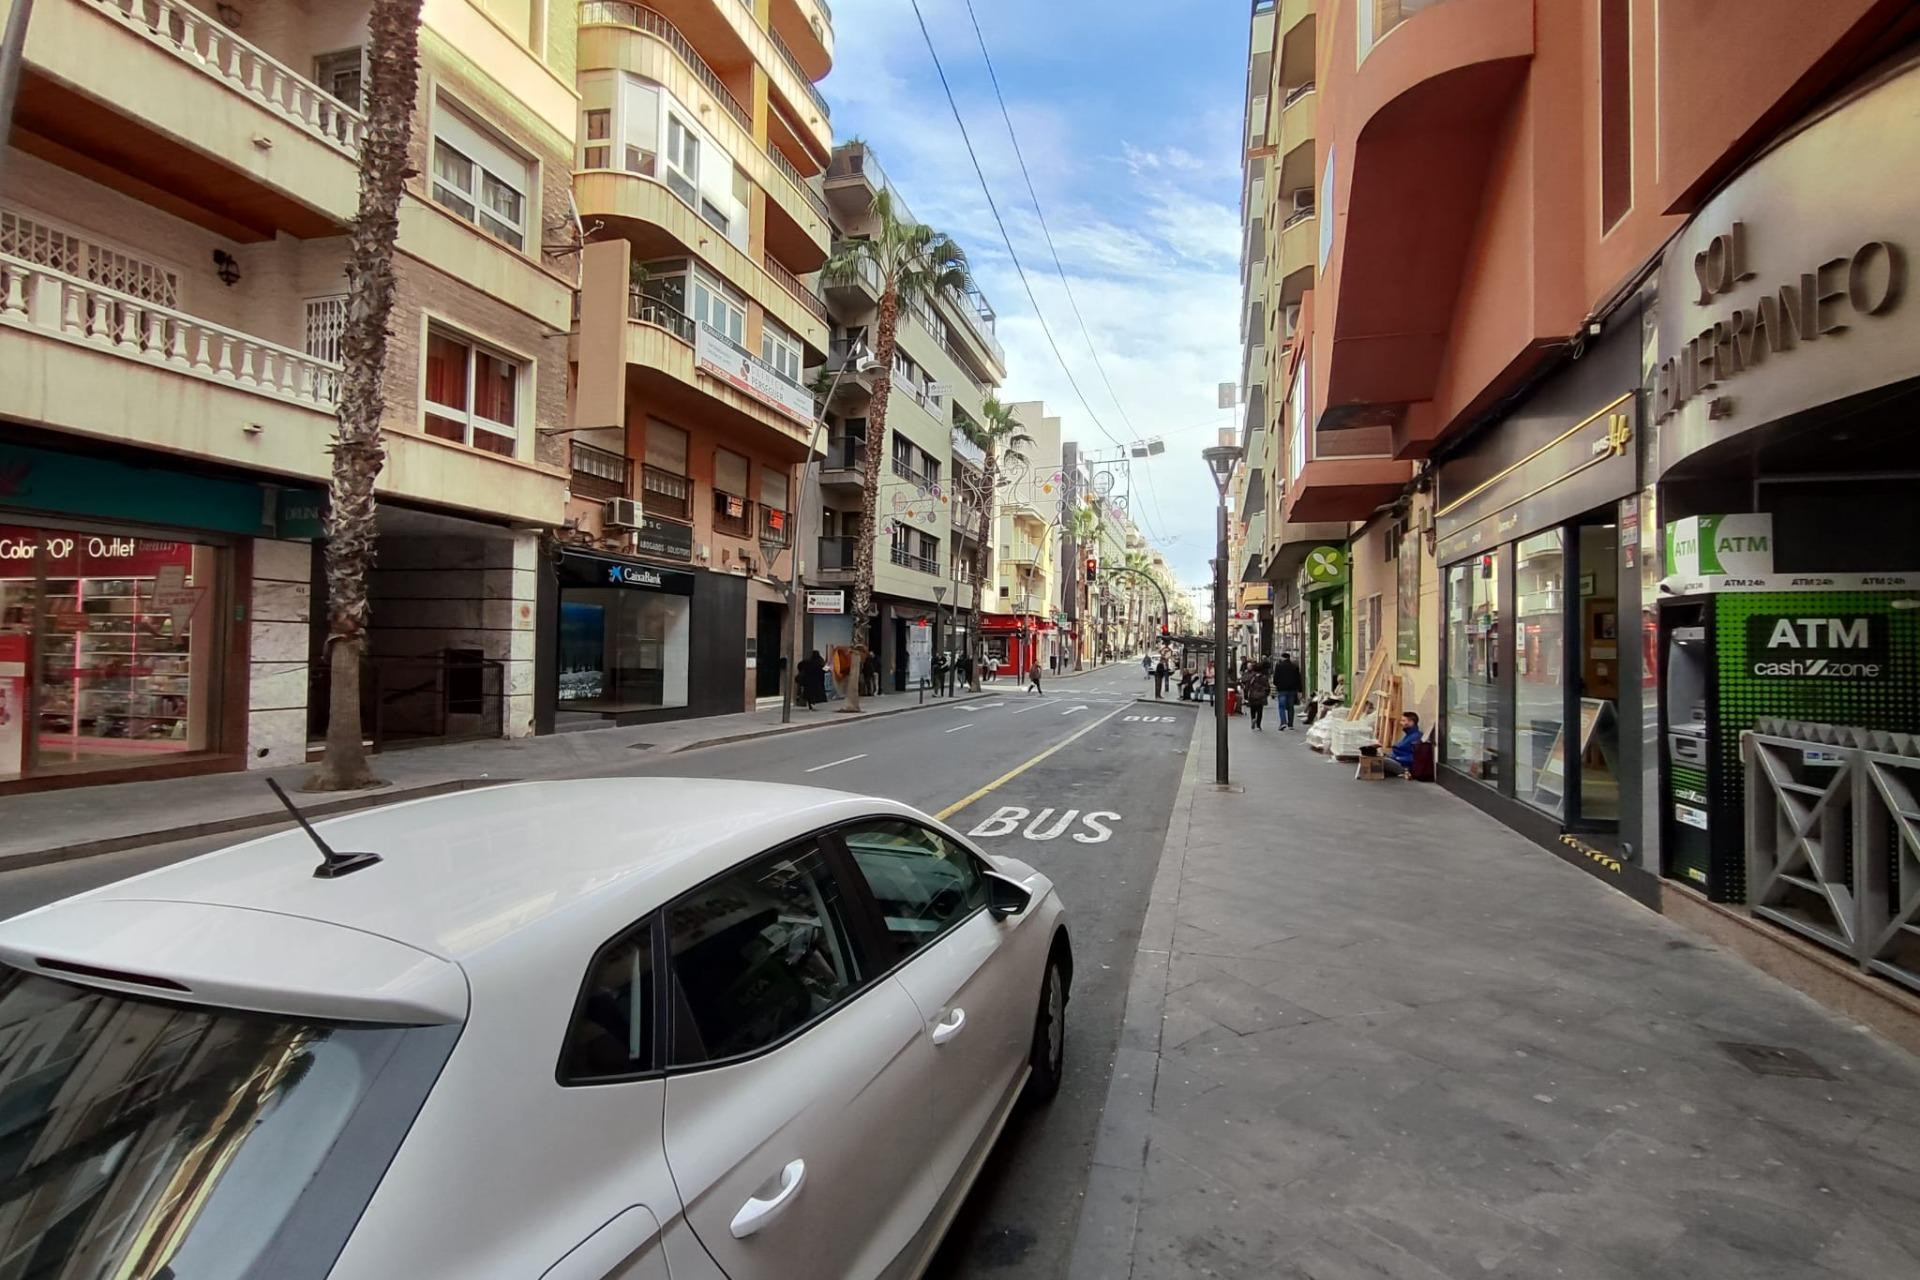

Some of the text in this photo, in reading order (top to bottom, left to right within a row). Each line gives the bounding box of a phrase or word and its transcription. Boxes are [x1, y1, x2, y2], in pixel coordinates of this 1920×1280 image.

[0, 538, 39, 559] Color
[46, 537, 75, 559] OP
[88, 537, 136, 558] Outlet
[1675, 538, 1697, 557] ATM
[1717, 536, 1768, 552] ATM
[624, 568, 661, 584] CaixaBank
[1724, 579, 1765, 587] ATM 24h
[1791, 578, 1834, 586] ATM 24h
[1861, 577, 1906, 585] ATM 24h
[1767, 618, 1869, 648] ATM
[967, 806, 1122, 844] BUS
